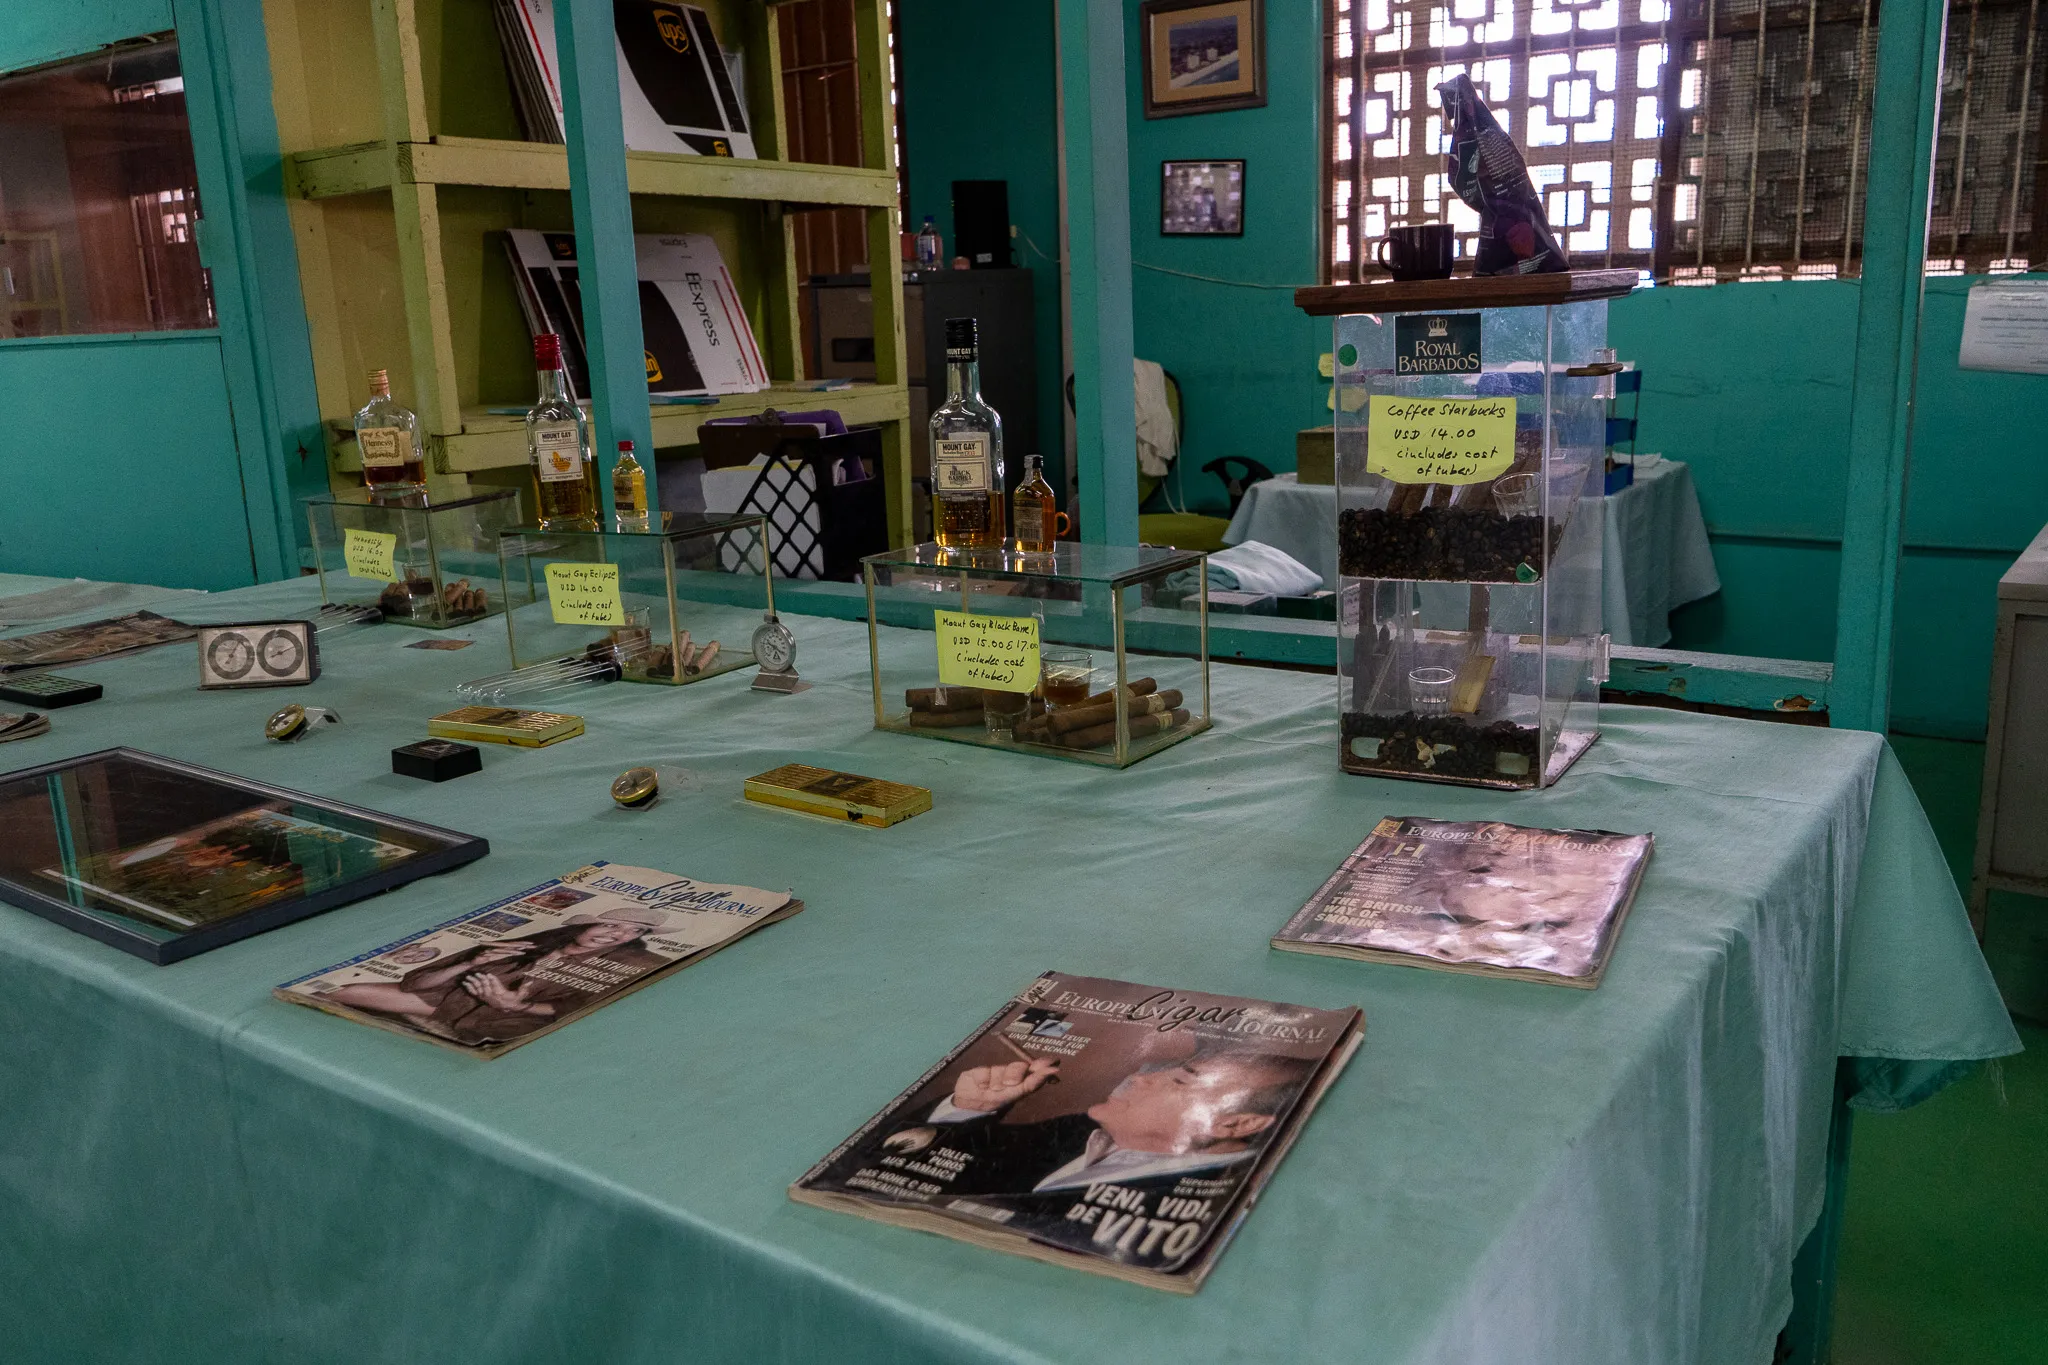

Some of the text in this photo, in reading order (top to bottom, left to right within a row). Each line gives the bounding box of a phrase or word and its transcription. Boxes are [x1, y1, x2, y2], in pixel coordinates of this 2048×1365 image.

[661, 21, 687, 46] ups
[689, 279, 720, 346] Express
[1415, 340, 1461, 357] ROYAL
[1399, 353, 1479, 373] BARBADOS
[1387, 402, 1506, 421] Coffee Starbucks
[1394, 428, 1476, 440] USD 14.00
[943, 443, 962, 451] MOUNT
[1465, 446, 1498, 459] cost
[1416, 463, 1433, 476] of
[552, 569, 616, 582] Mount Gay Eclipse
[580, 584, 603, 593] 14.00
[596, 599, 613, 609] cost
[580, 611, 589, 620] of
[942, 618, 966, 628] Mount
[969, 620, 986, 634] Gay
[989, 620, 1011, 631] Black
[977, 638, 1004, 649] 15.00
[1003, 656, 1025, 667] cost
[968, 668, 1015, 684] of tubes)
[589, 876, 662, 901] EUROPEN
[1323, 904, 1382, 919] WAY OF
[1331, 896, 1425, 914] THE BRITISH
[1314, 913, 1386, 929] SMOKING
[582, 956, 647, 975] RHYTHMUS
[562, 964, 630, 984] KARIBISCHE
[1054, 990, 1329, 1040] EUROPEAN Cigar JOURNAL
[1008, 1032, 1027, 1040] UND
[1028, 1035, 1064, 1047] FLAMME
[1062, 1033, 1092, 1044] FEUER
[1022, 1042, 1080, 1057] DAS SCHÖNE
[880, 1155, 957, 1182] AUS JAMAICA
[928, 1156, 967, 1172] PUROS
[856, 1168, 880, 1178] DAS
[917, 1181, 942, 1194] DER
[1173, 1186, 1193, 1194] DER
[1083, 1182, 1213, 1222] VENI, VIDI,
[1066, 1202, 1200, 1259] DE VITO
